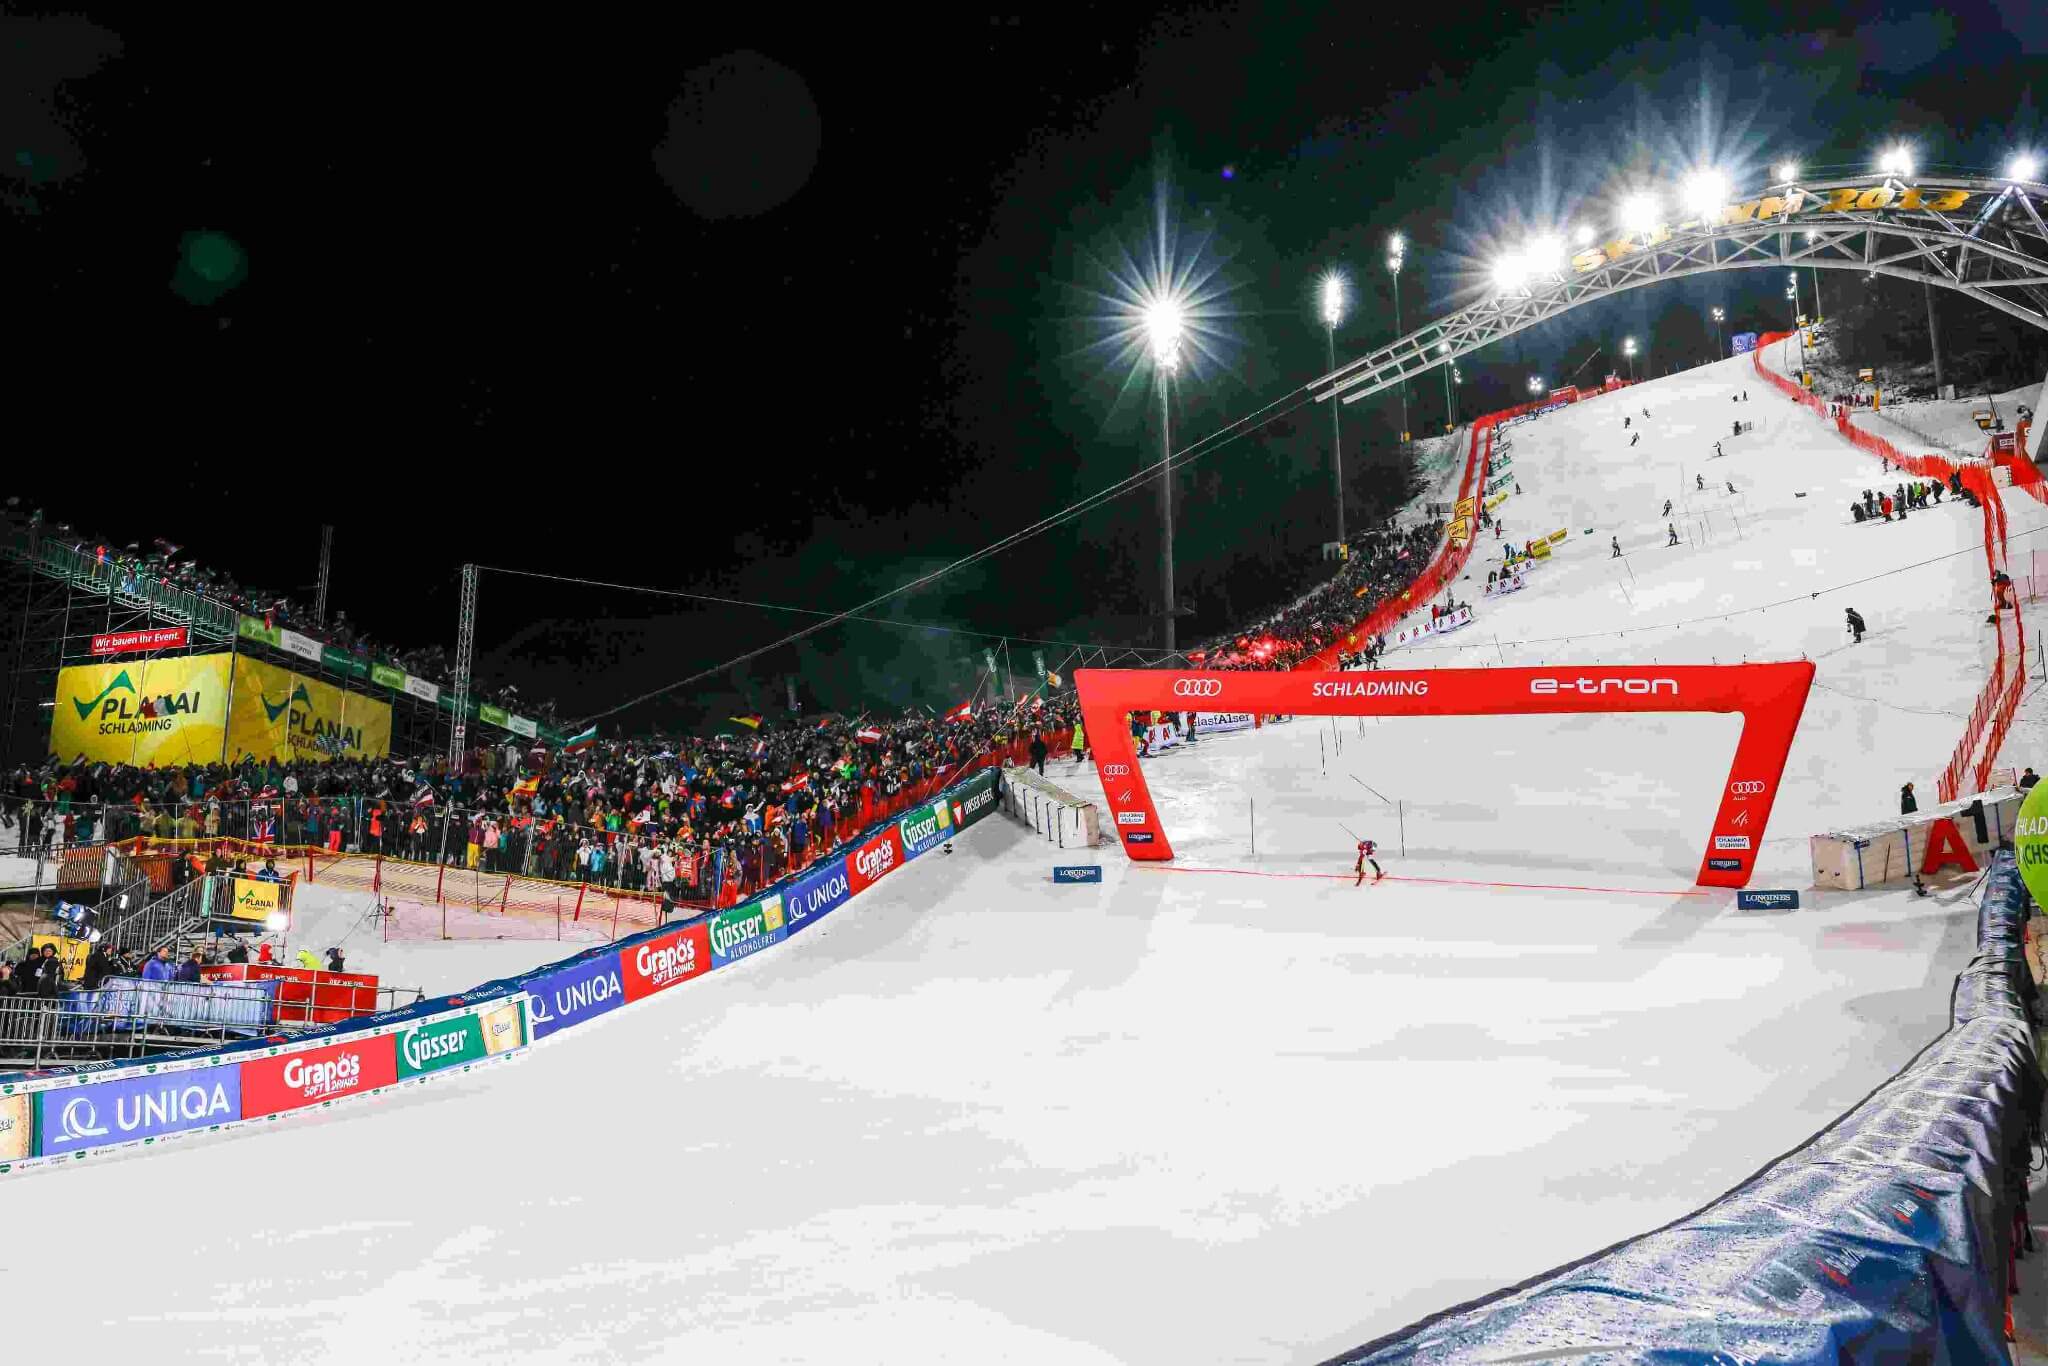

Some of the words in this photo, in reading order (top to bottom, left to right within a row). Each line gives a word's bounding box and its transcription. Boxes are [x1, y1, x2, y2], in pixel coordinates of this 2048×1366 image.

[95, 638, 111, 648] Wir
[112, 635, 137, 646] bauen
[139, 634, 151, 644] Ihr
[154, 631, 180, 642] Event.
[1312, 680, 1429, 697] SCHLADMING
[1530, 678, 1678, 695] e-tron
[98, 719, 172, 735] SCHLADMING
[900, 815, 936, 852] Gösser
[245, 898, 274, 908] PLANAI
[807, 873, 848, 912] UNIQA
[1745, 894, 1791, 902] LONGINES
[710, 914, 762, 957] Gösser
[730, 932, 776, 961] ALKOHOLFREI
[556, 971, 622, 1016] UNIQA
[402, 1026, 468, 1070] Gösser
[303, 1080, 323, 1097] SOFT
[330, 1076, 359, 1092] DRINKS
[116, 1083, 231, 1132] UNIQA
